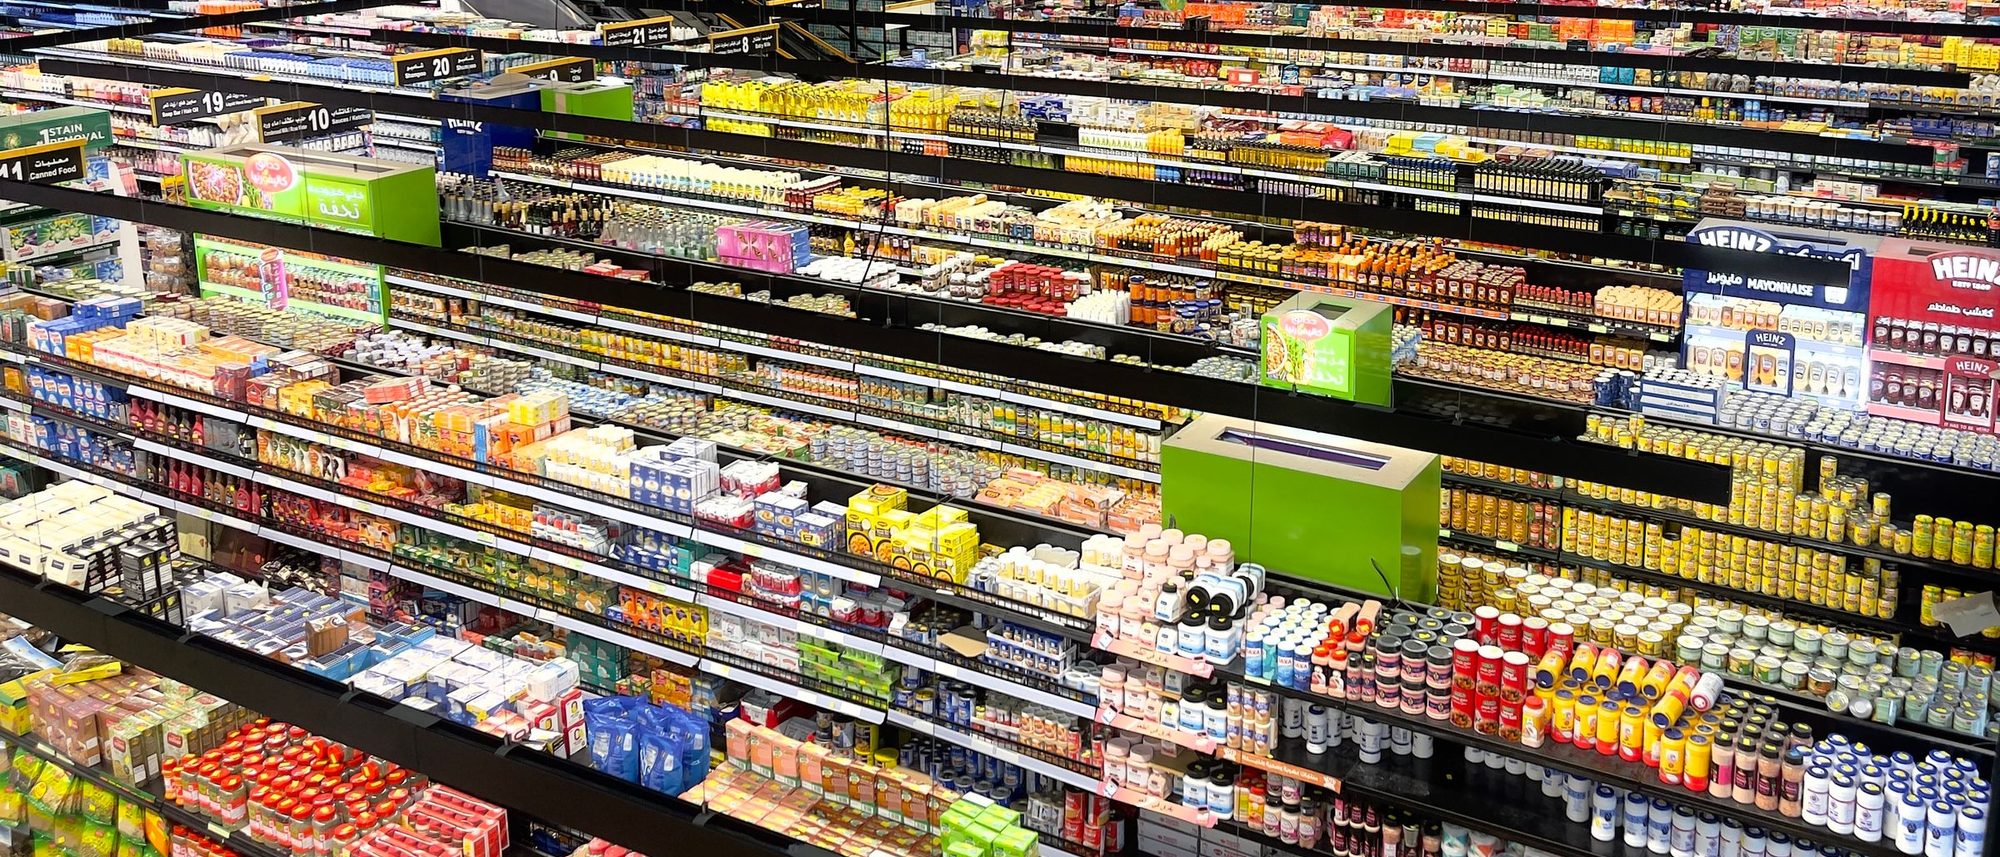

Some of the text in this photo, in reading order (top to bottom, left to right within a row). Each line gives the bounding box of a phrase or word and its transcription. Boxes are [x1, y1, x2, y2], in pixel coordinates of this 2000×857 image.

[632, 27, 645, 44] 21
[742, 36, 749, 53] 8
[432, 57, 450, 77] 20
[202, 91, 224, 114] 19
[309, 108, 330, 131] 10
[331, 117, 349, 125] Sauces
[352, 113, 371, 121] Ketchup
[48, 123, 83, 137] STAIN
[0, 160, 23, 181] 11
[30, 165, 77, 180] Canned Food
[319, 198, 360, 219] تحفة
[1698, 229, 1772, 253] HEINZ
[1706, 271, 1743, 286] مايونيز
[1746, 277, 1814, 298] MAYONNAISE
[1755, 332, 1786, 346] HEINZ
[1955, 360, 1990, 374] HEINZ
